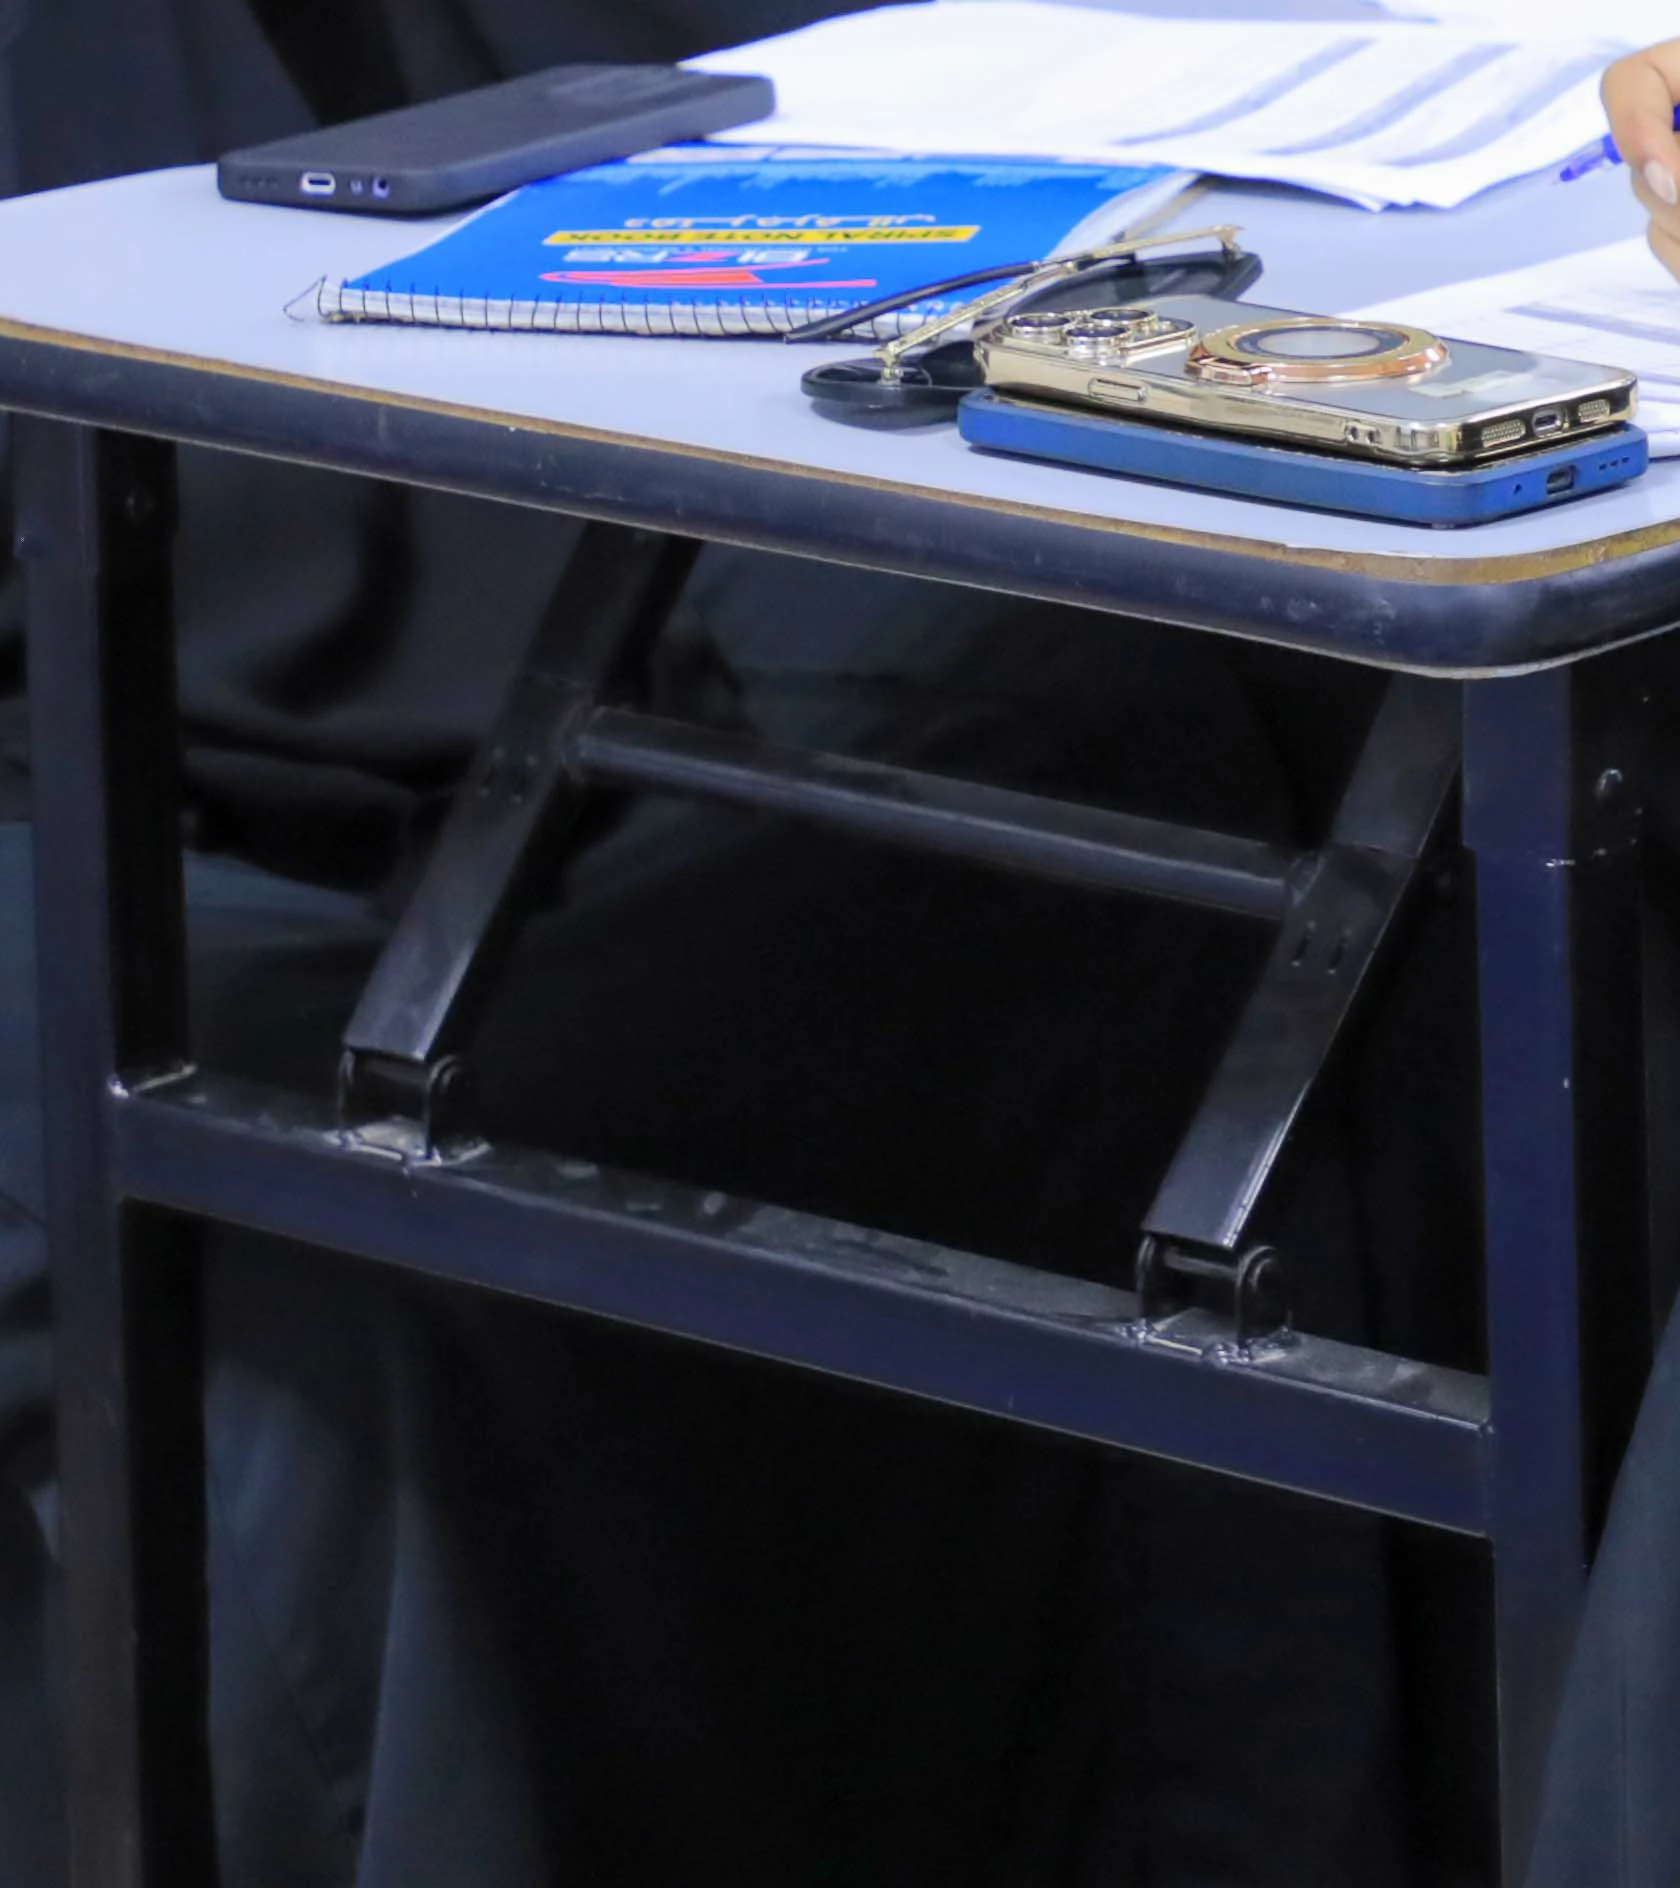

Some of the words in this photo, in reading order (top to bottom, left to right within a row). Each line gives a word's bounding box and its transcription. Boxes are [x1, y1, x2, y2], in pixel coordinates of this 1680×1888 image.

[569, 231, 681, 242] BOOK
[702, 230, 804, 241] NOTE
[822, 228, 957, 240] SPIRAL
